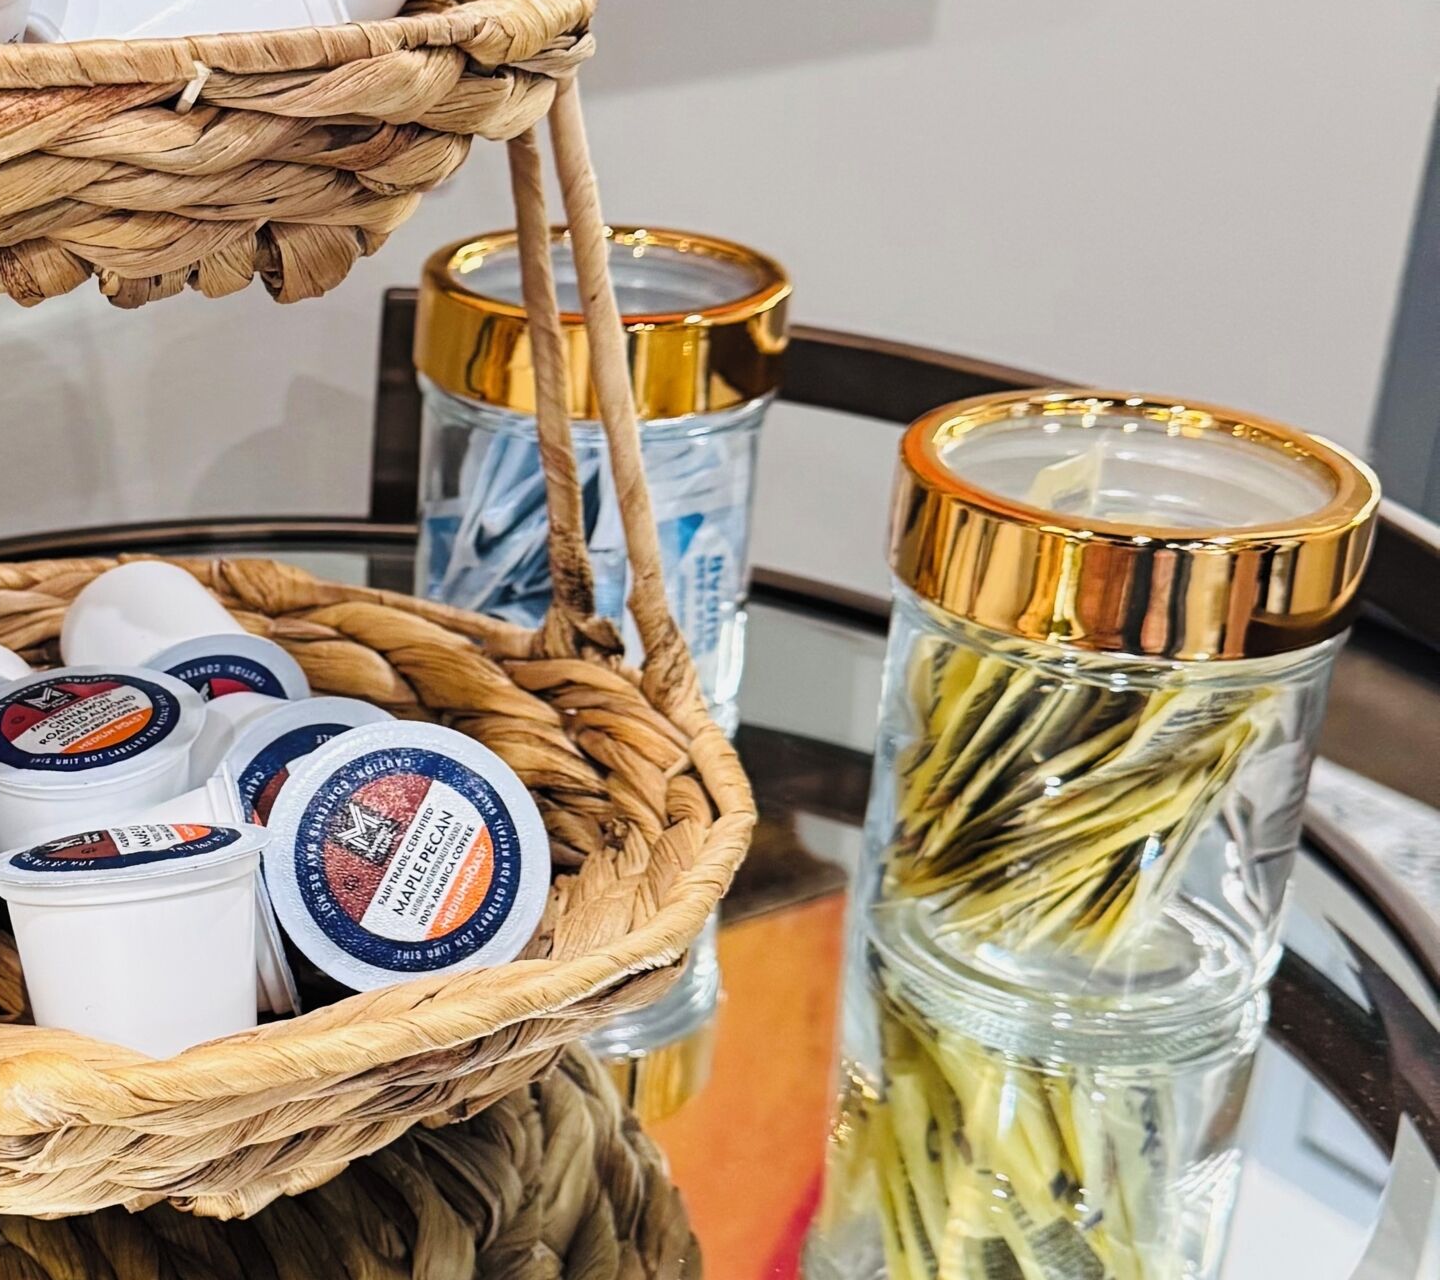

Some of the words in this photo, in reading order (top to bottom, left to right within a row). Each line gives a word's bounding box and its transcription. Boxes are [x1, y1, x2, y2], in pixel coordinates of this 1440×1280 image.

[39, 714, 89, 745] ROASTED
[78, 728, 115, 751] MEDIUM
[116, 713, 145, 730] ROAST
[310, 780, 353, 842] CONTENTS
[377, 884, 394, 906] FAIR
[389, 852, 411, 886] TRADE
[405, 806, 434, 854] CERTIFIED
[494, 818, 511, 859] RETAIL
[392, 862, 428, 916] MAPLE
[419, 810, 455, 864] PECAN
[418, 900, 437, 926] 100%
[432, 861, 457, 902] ARABICA
[453, 824, 476, 861] COFFEE
[499, 861, 512, 885] FOR
[475, 886, 507, 935] LABELED
[397, 949, 422, 960] THIS
[427, 943, 452, 959] UNIT
[455, 930, 475, 948] NOT
